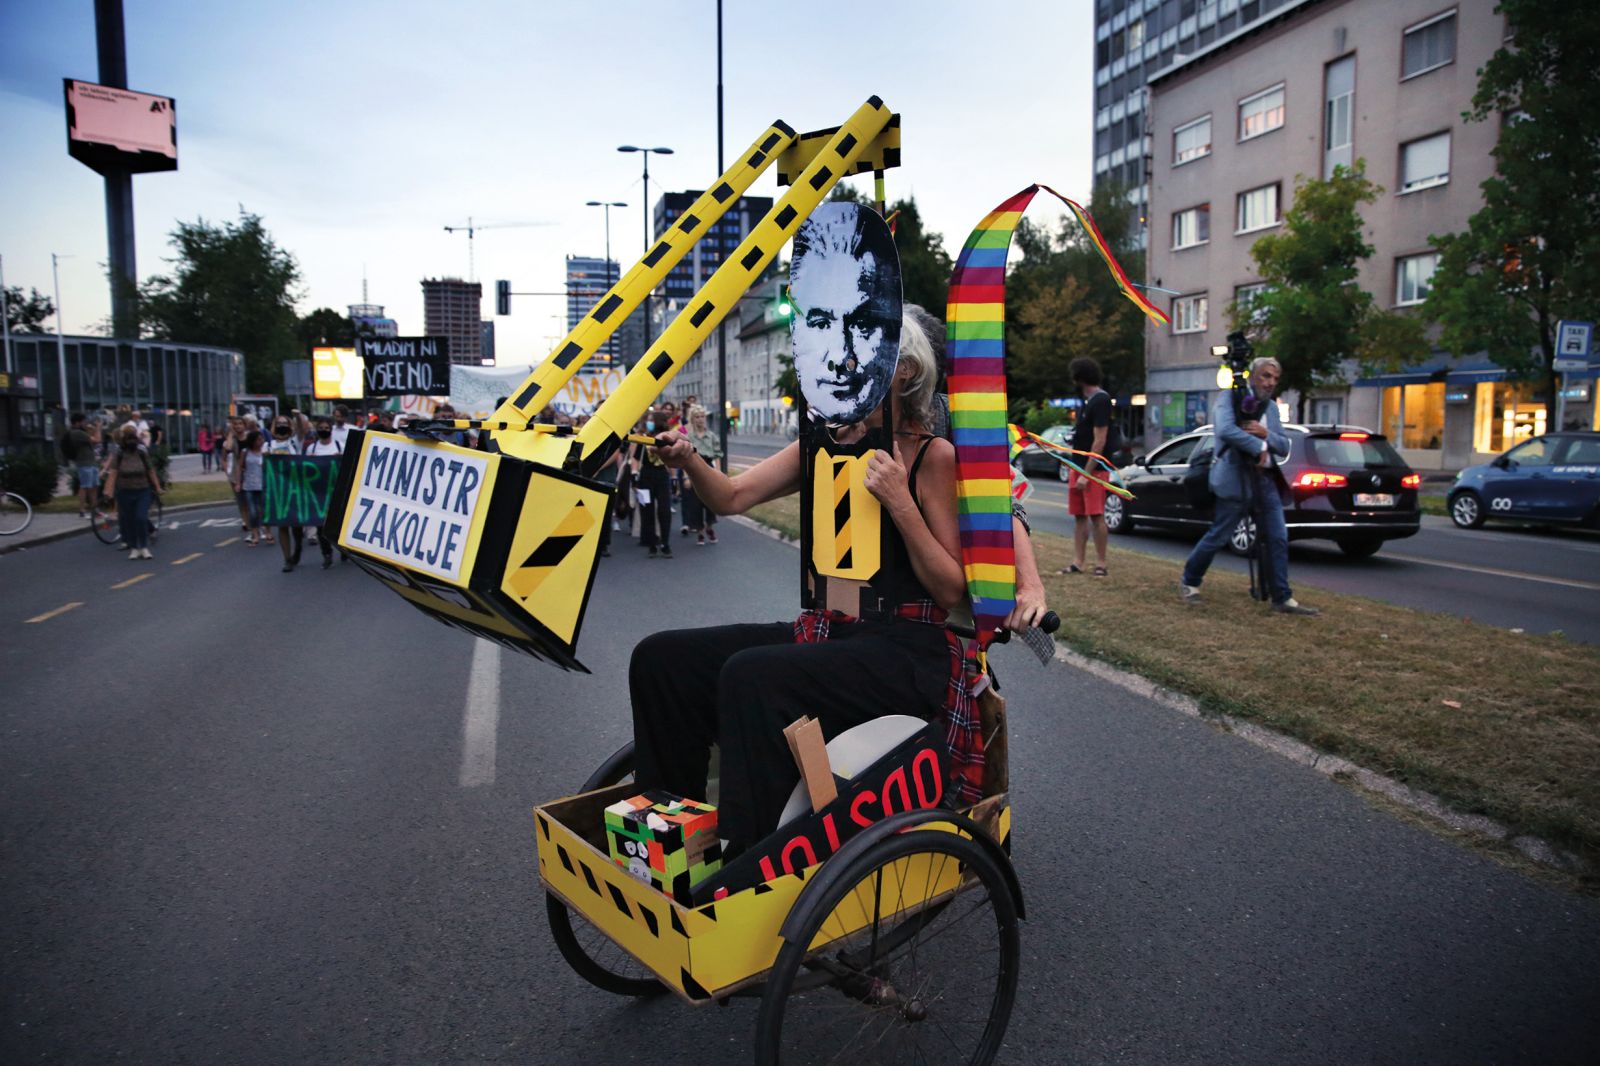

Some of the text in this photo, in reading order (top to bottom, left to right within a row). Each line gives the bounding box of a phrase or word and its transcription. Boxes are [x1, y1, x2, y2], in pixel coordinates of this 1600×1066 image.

[149, 101, 166, 113] A1
[1568, 328, 1585, 336] TAXI
[364, 339, 437, 356] MLADIM NI
[83, 368, 148, 389] VHOD
[364, 445, 479, 516] MINISTR
[351, 497, 462, 571] ZAKOLJE
